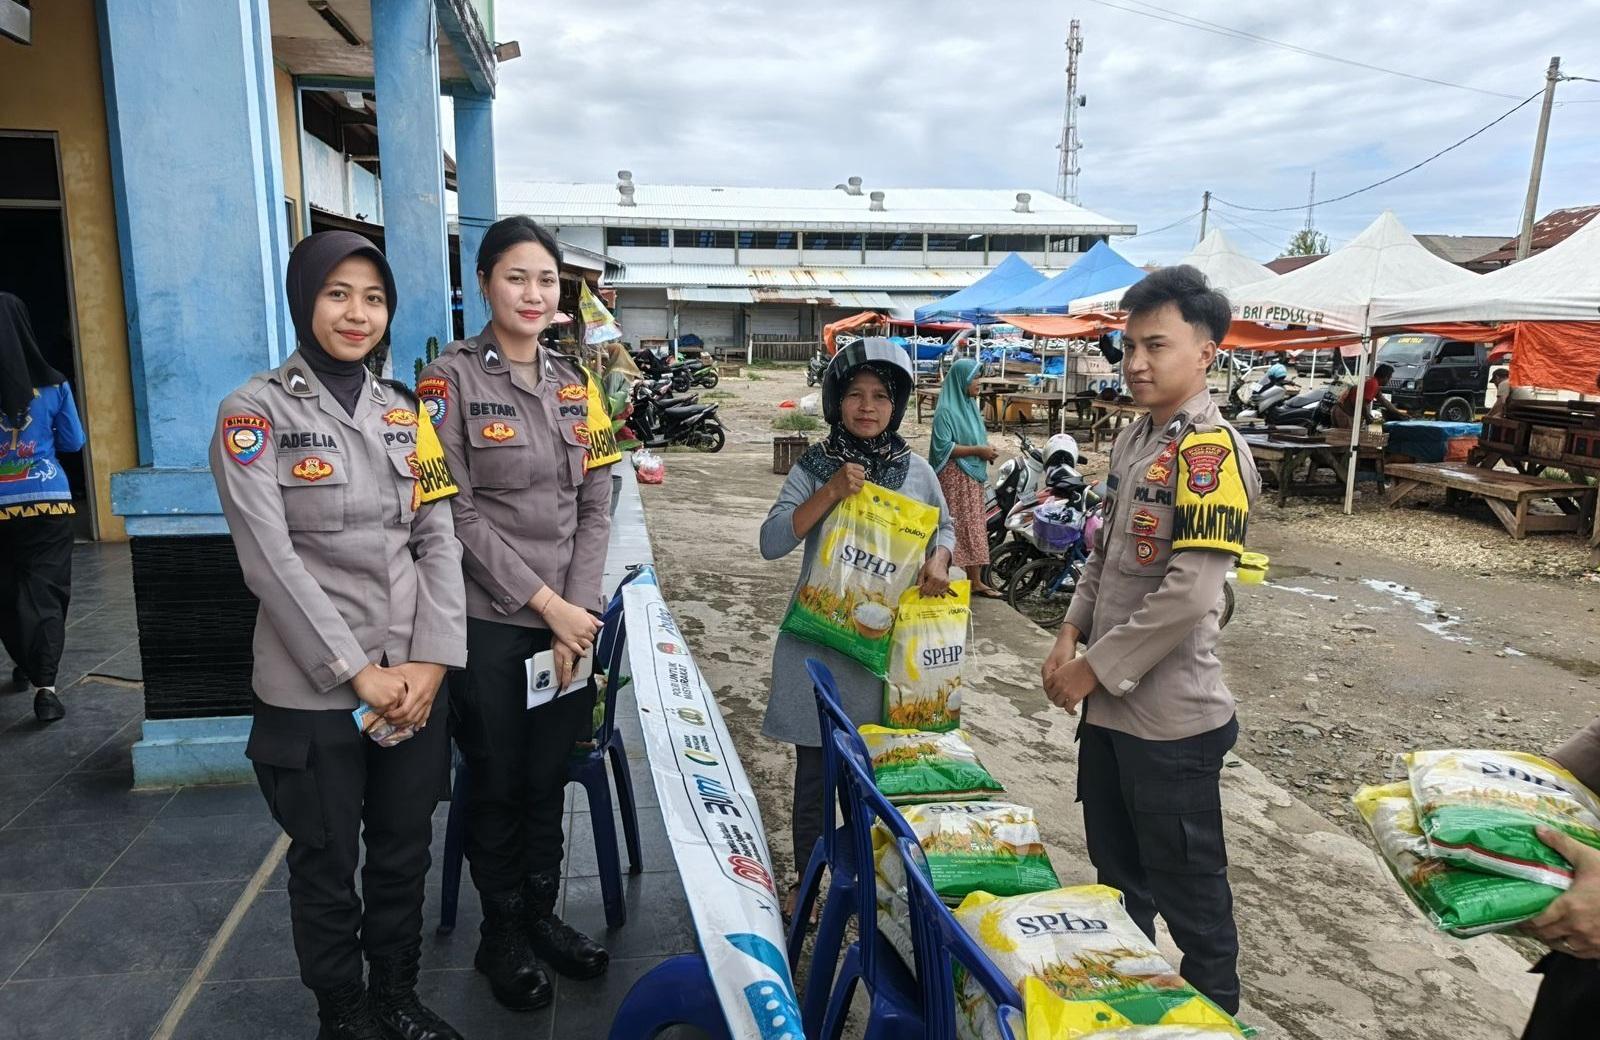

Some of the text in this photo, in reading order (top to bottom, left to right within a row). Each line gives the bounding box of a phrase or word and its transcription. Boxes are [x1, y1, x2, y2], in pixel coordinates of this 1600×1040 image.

[1243, 305, 1262, 319] BRI
[469, 402, 517, 417] BETARI
[280, 432, 338, 448] ADELIA
[904, 526, 926, 539] bulog
[840, 544, 897, 577] SPHP
[923, 645, 962, 666] SPHP
[970, 841, 980, 851] 5
[1088, 975, 1104, 988] 5
